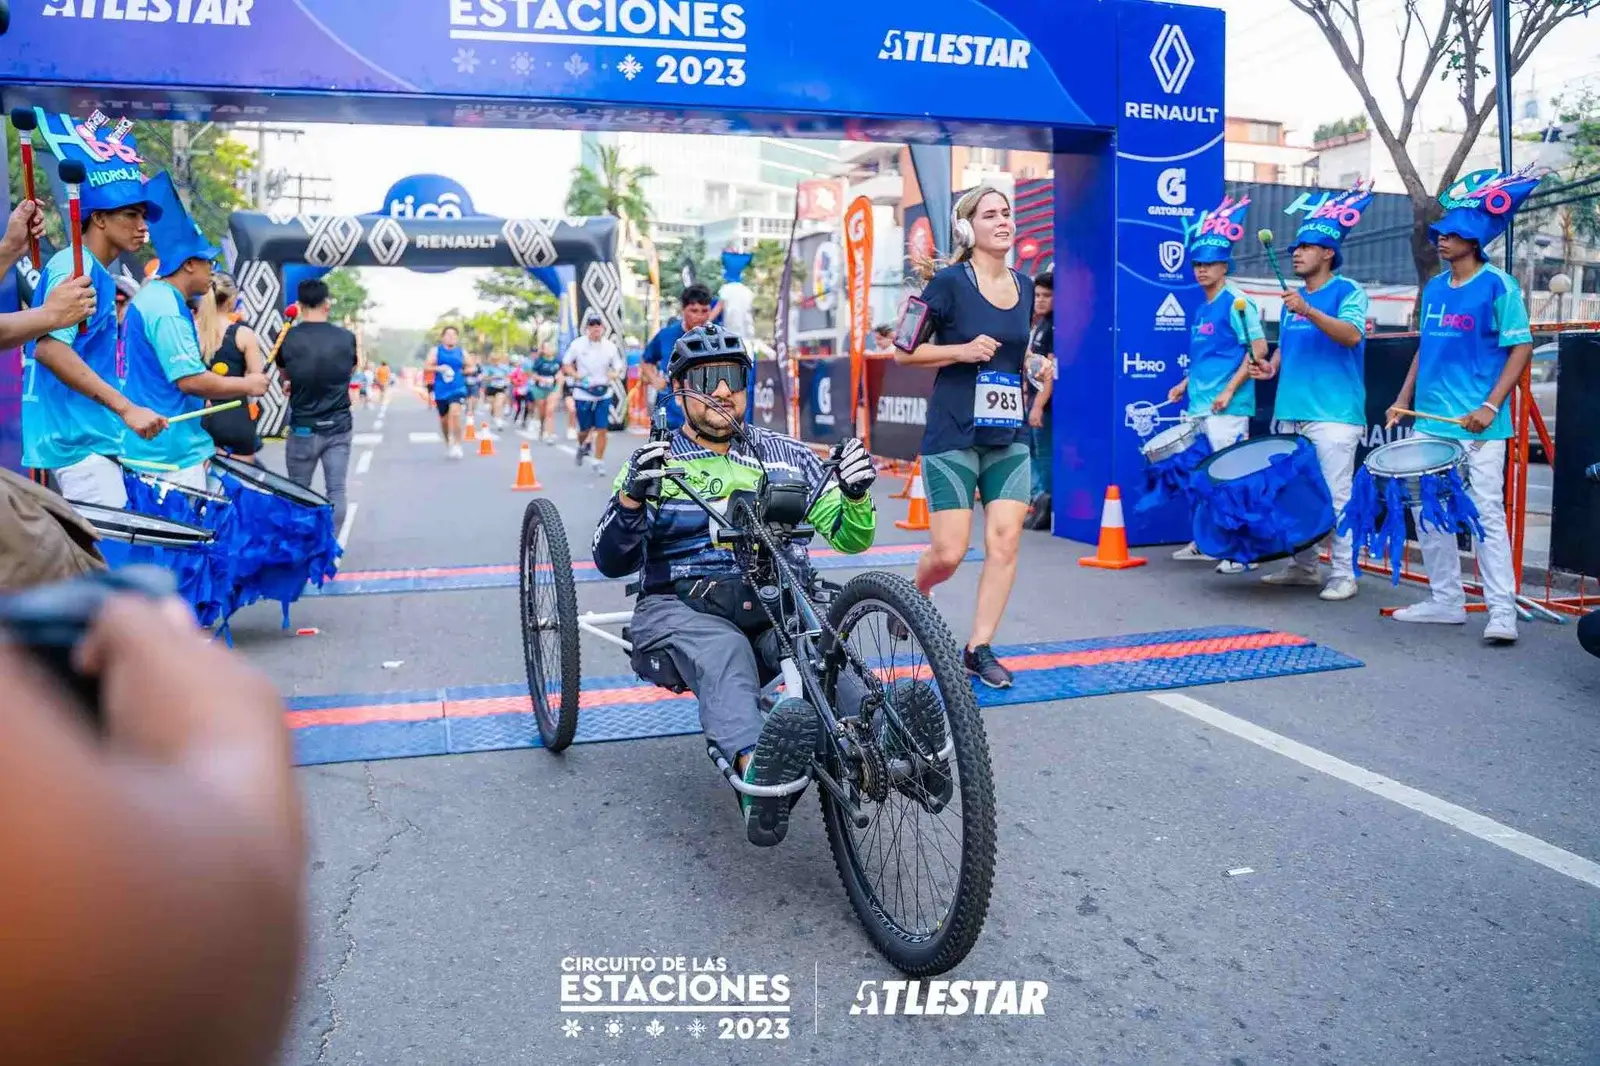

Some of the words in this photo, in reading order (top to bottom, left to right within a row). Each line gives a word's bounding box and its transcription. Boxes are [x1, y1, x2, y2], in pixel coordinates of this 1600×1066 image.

[449, 0, 748, 40] ESTACIONES
[878, 29, 1031, 69] ATLESTAR
[656, 55, 747, 87] 2023
[1125, 102, 1220, 124] RENAULT
[1157, 168, 1187, 205] G
[416, 234, 499, 249] RENAULT
[1424, 303, 1475, 331] HPRO
[1123, 352, 1166, 374] HPRO
[986, 390, 1018, 411] 983
